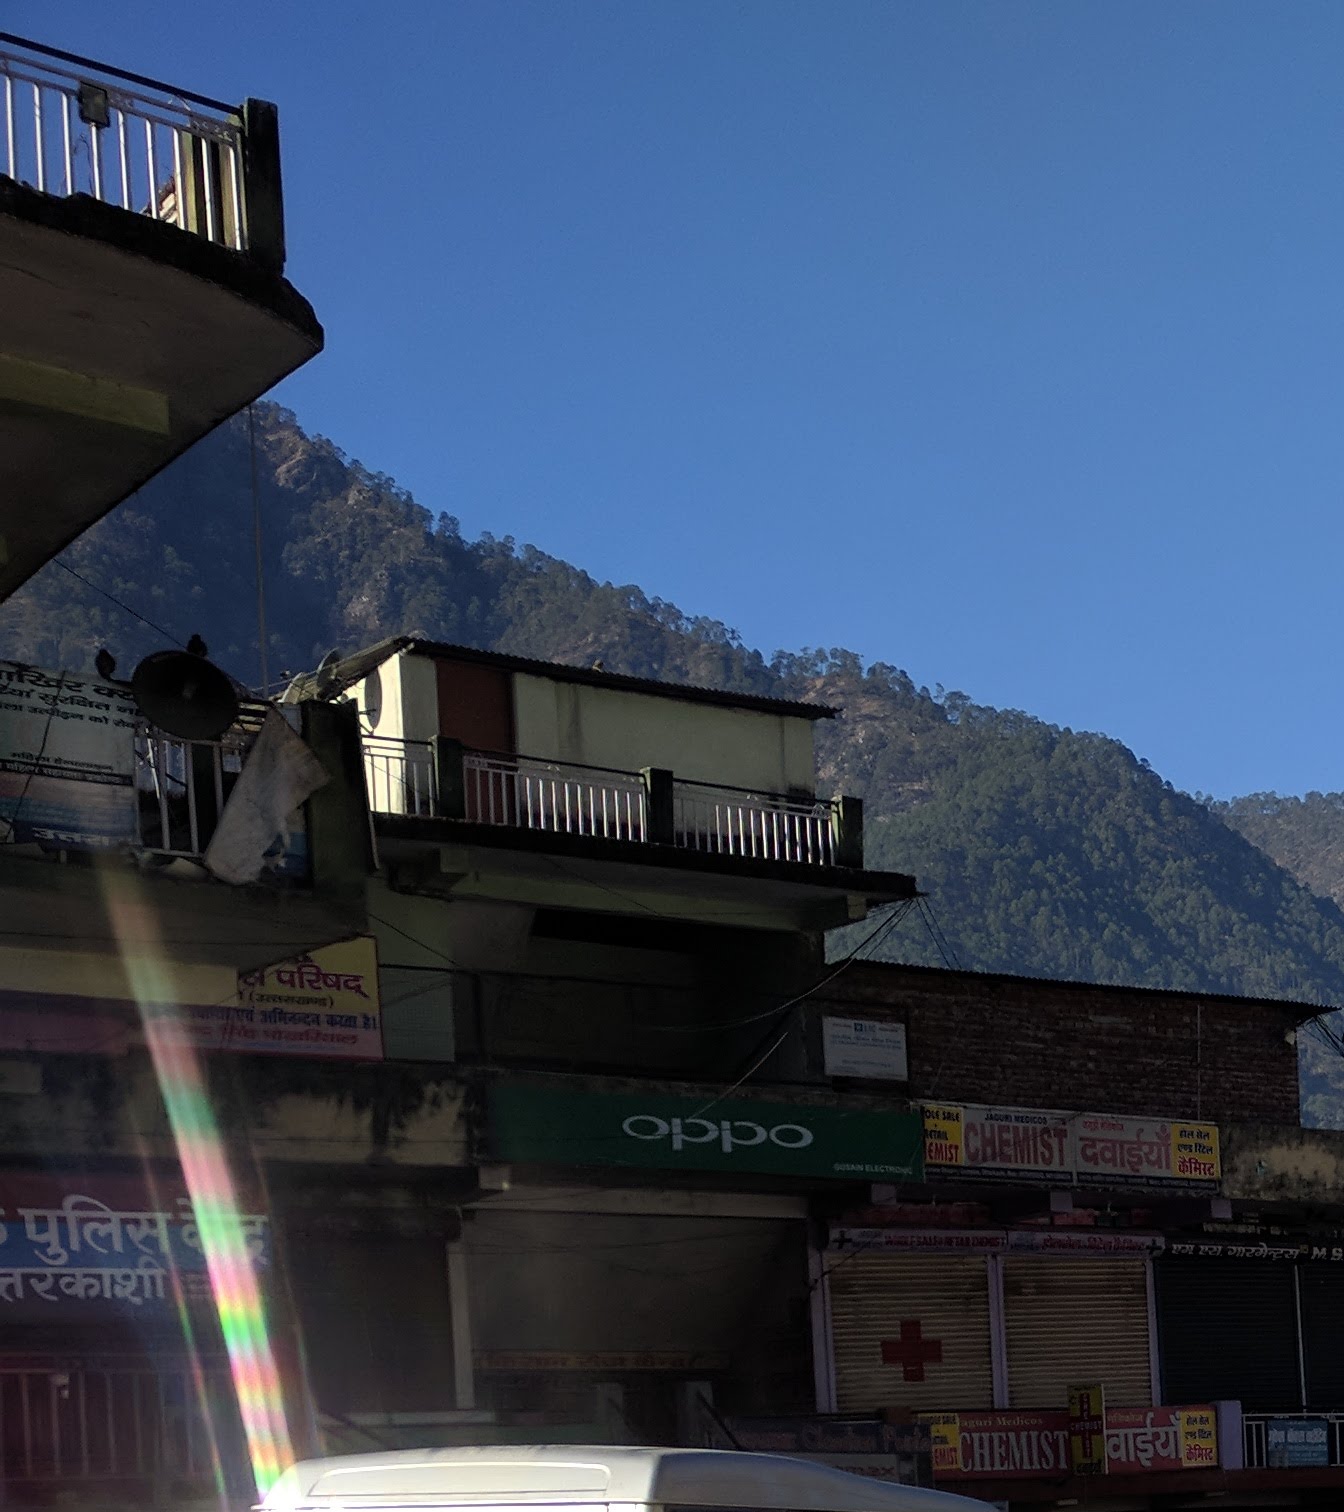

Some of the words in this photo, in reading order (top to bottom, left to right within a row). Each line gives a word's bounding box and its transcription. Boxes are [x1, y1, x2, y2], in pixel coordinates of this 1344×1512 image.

[964, 1121, 1068, 1167] CHEMIST
[18, 1195, 173, 1266] पुलिस
[0, 1256, 168, 1305] त्तरकाशी
[960, 1430, 1069, 1471] CHEMIST
